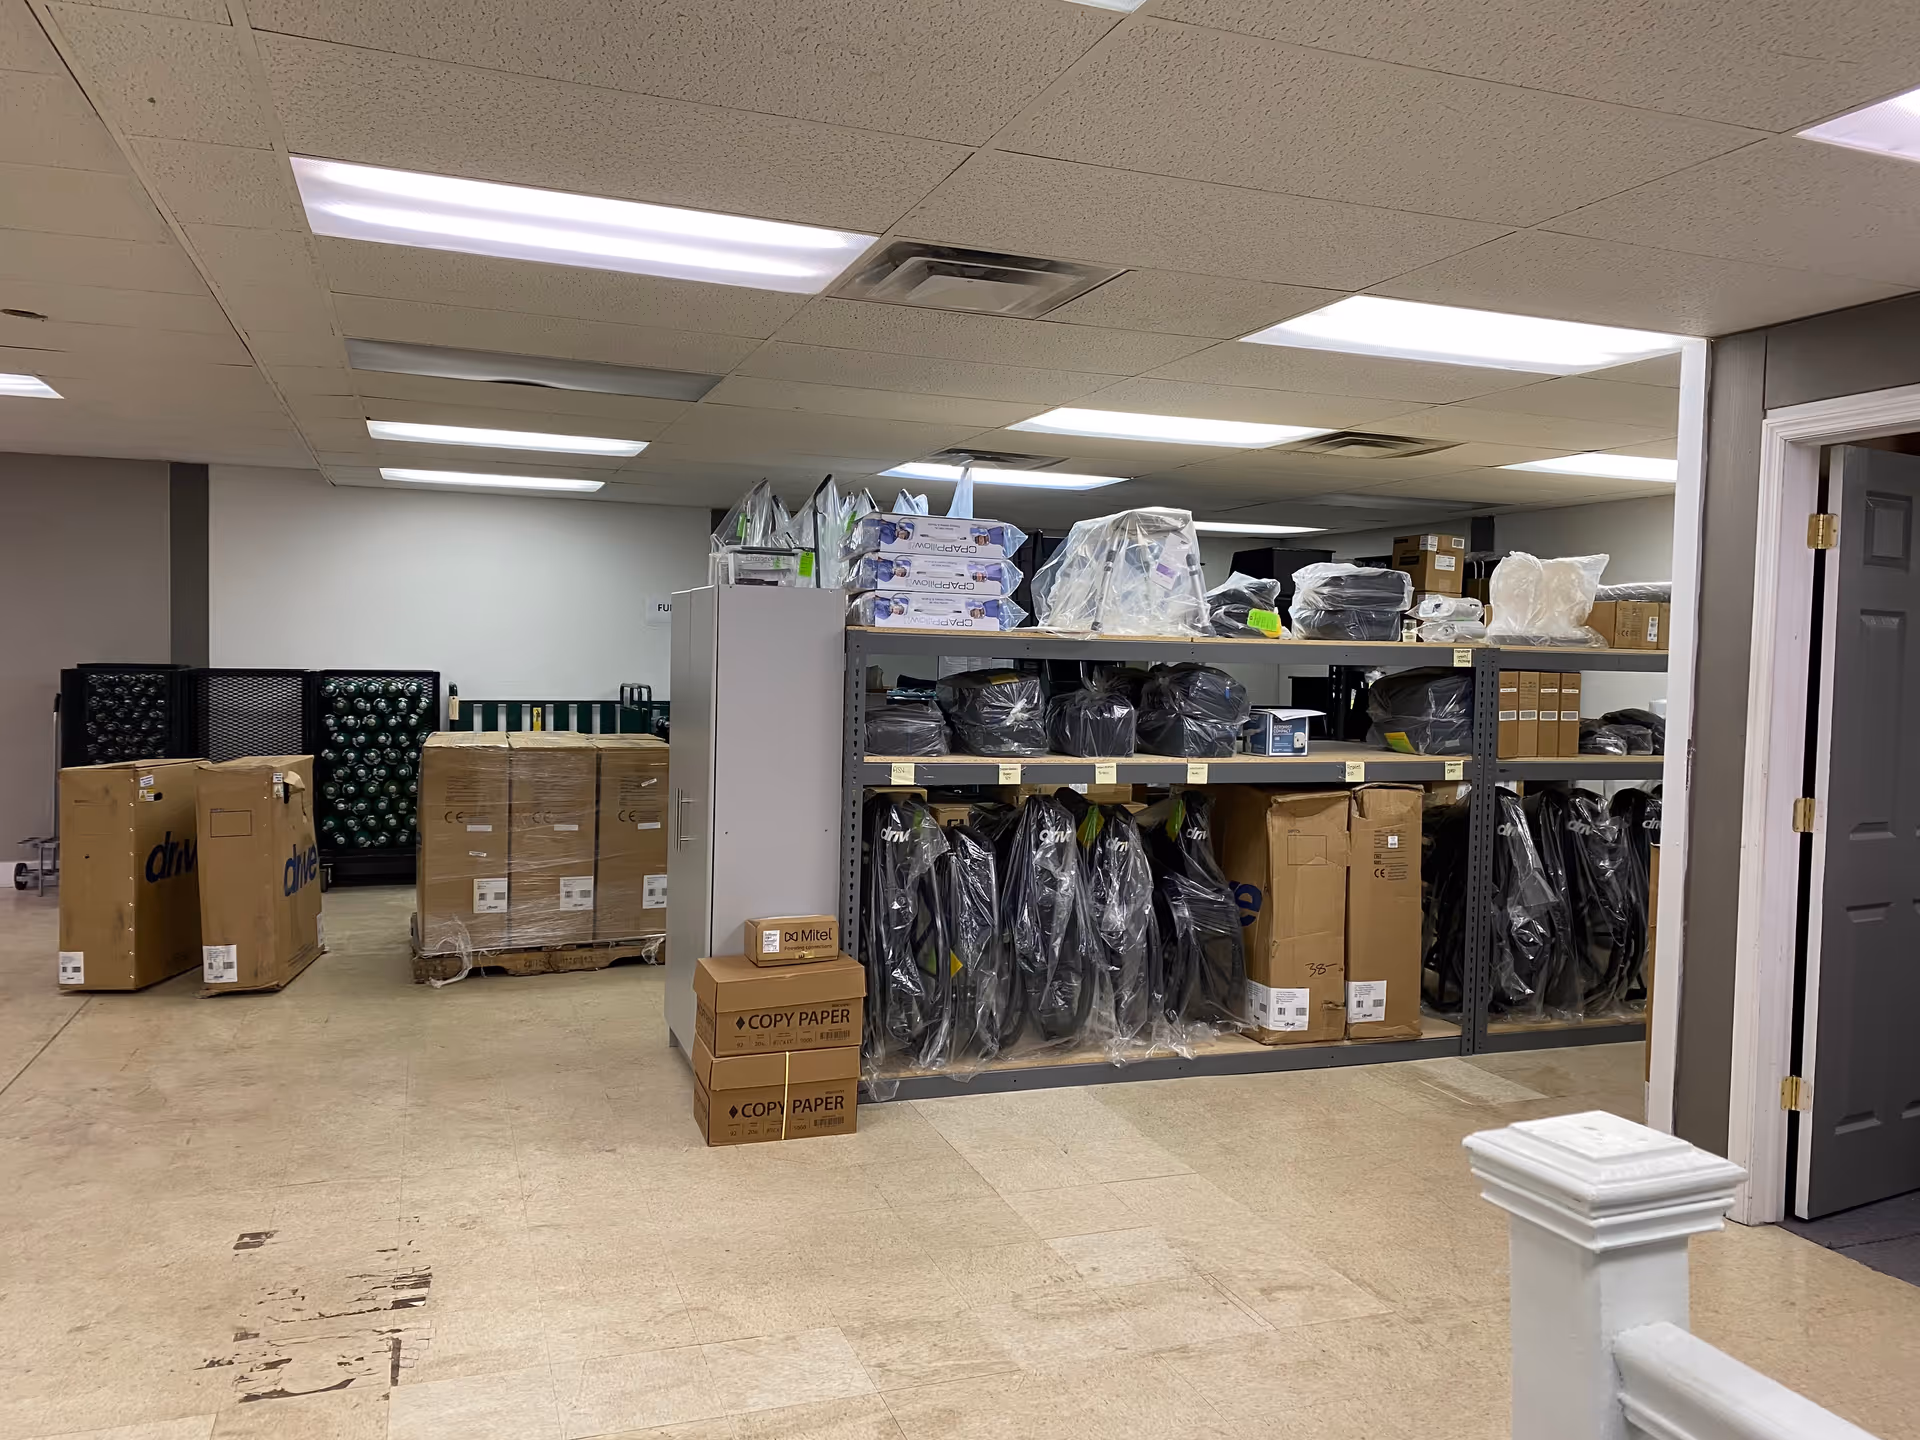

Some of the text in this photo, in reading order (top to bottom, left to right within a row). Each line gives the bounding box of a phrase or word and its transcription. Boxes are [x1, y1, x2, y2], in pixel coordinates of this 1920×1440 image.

[145, 831, 198, 884] driv
[284, 843, 317, 897] drive
[801, 928, 833, 942] Mitel
[748, 1008, 850, 1030] COPY PAPER
[741, 1095, 845, 1118] COPY PAPER
